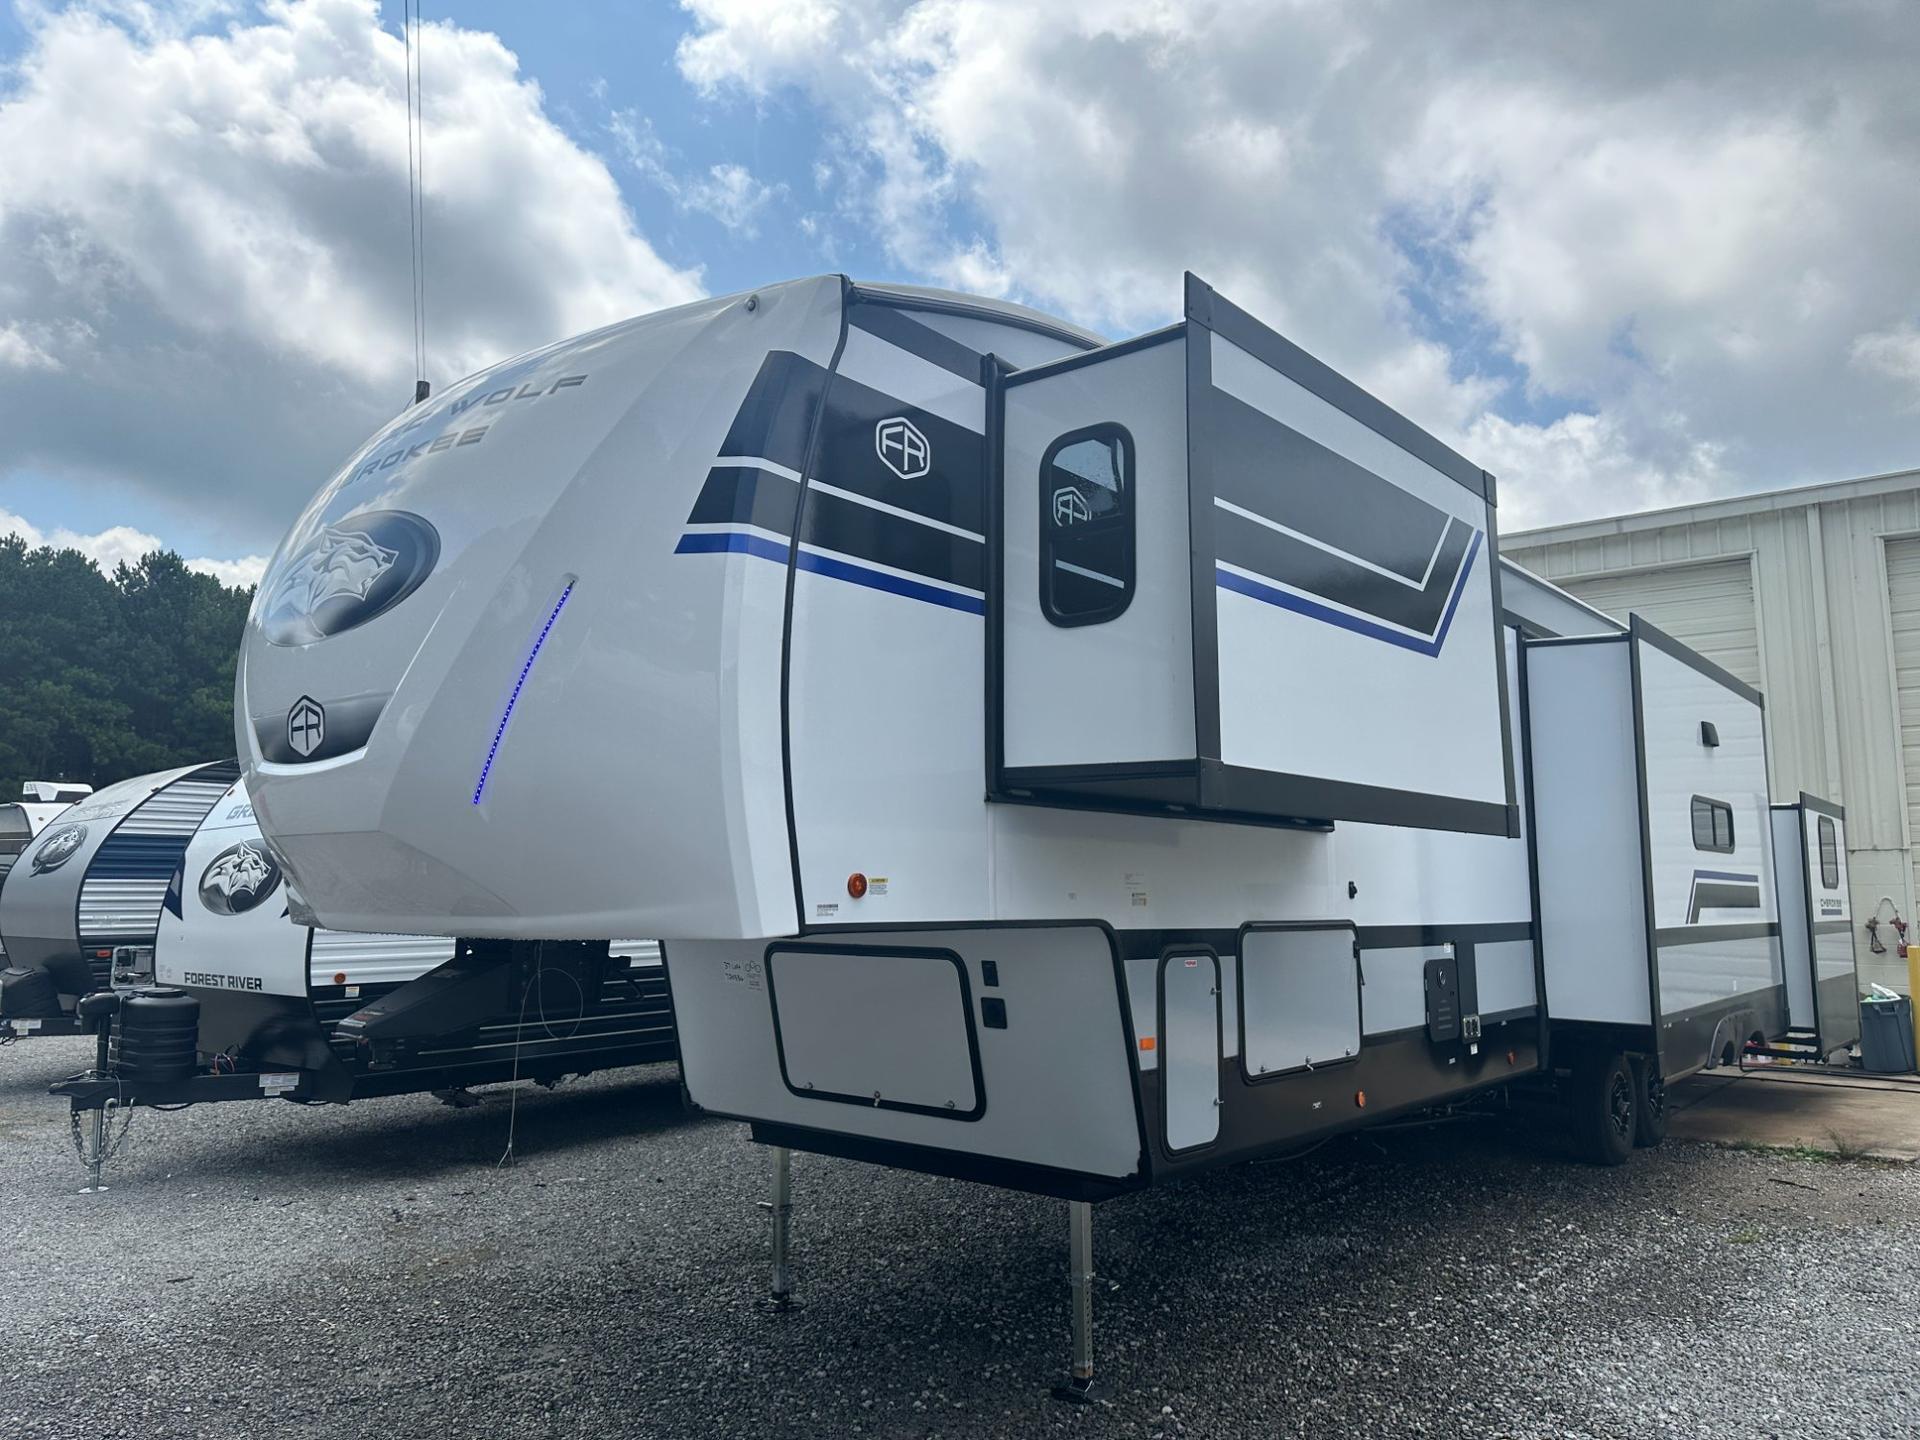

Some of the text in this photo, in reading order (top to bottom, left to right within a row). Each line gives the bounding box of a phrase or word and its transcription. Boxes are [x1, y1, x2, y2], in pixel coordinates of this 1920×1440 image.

[451, 374, 588, 415] WOLF
[184, 971, 263, 991] FOREST RIVER
